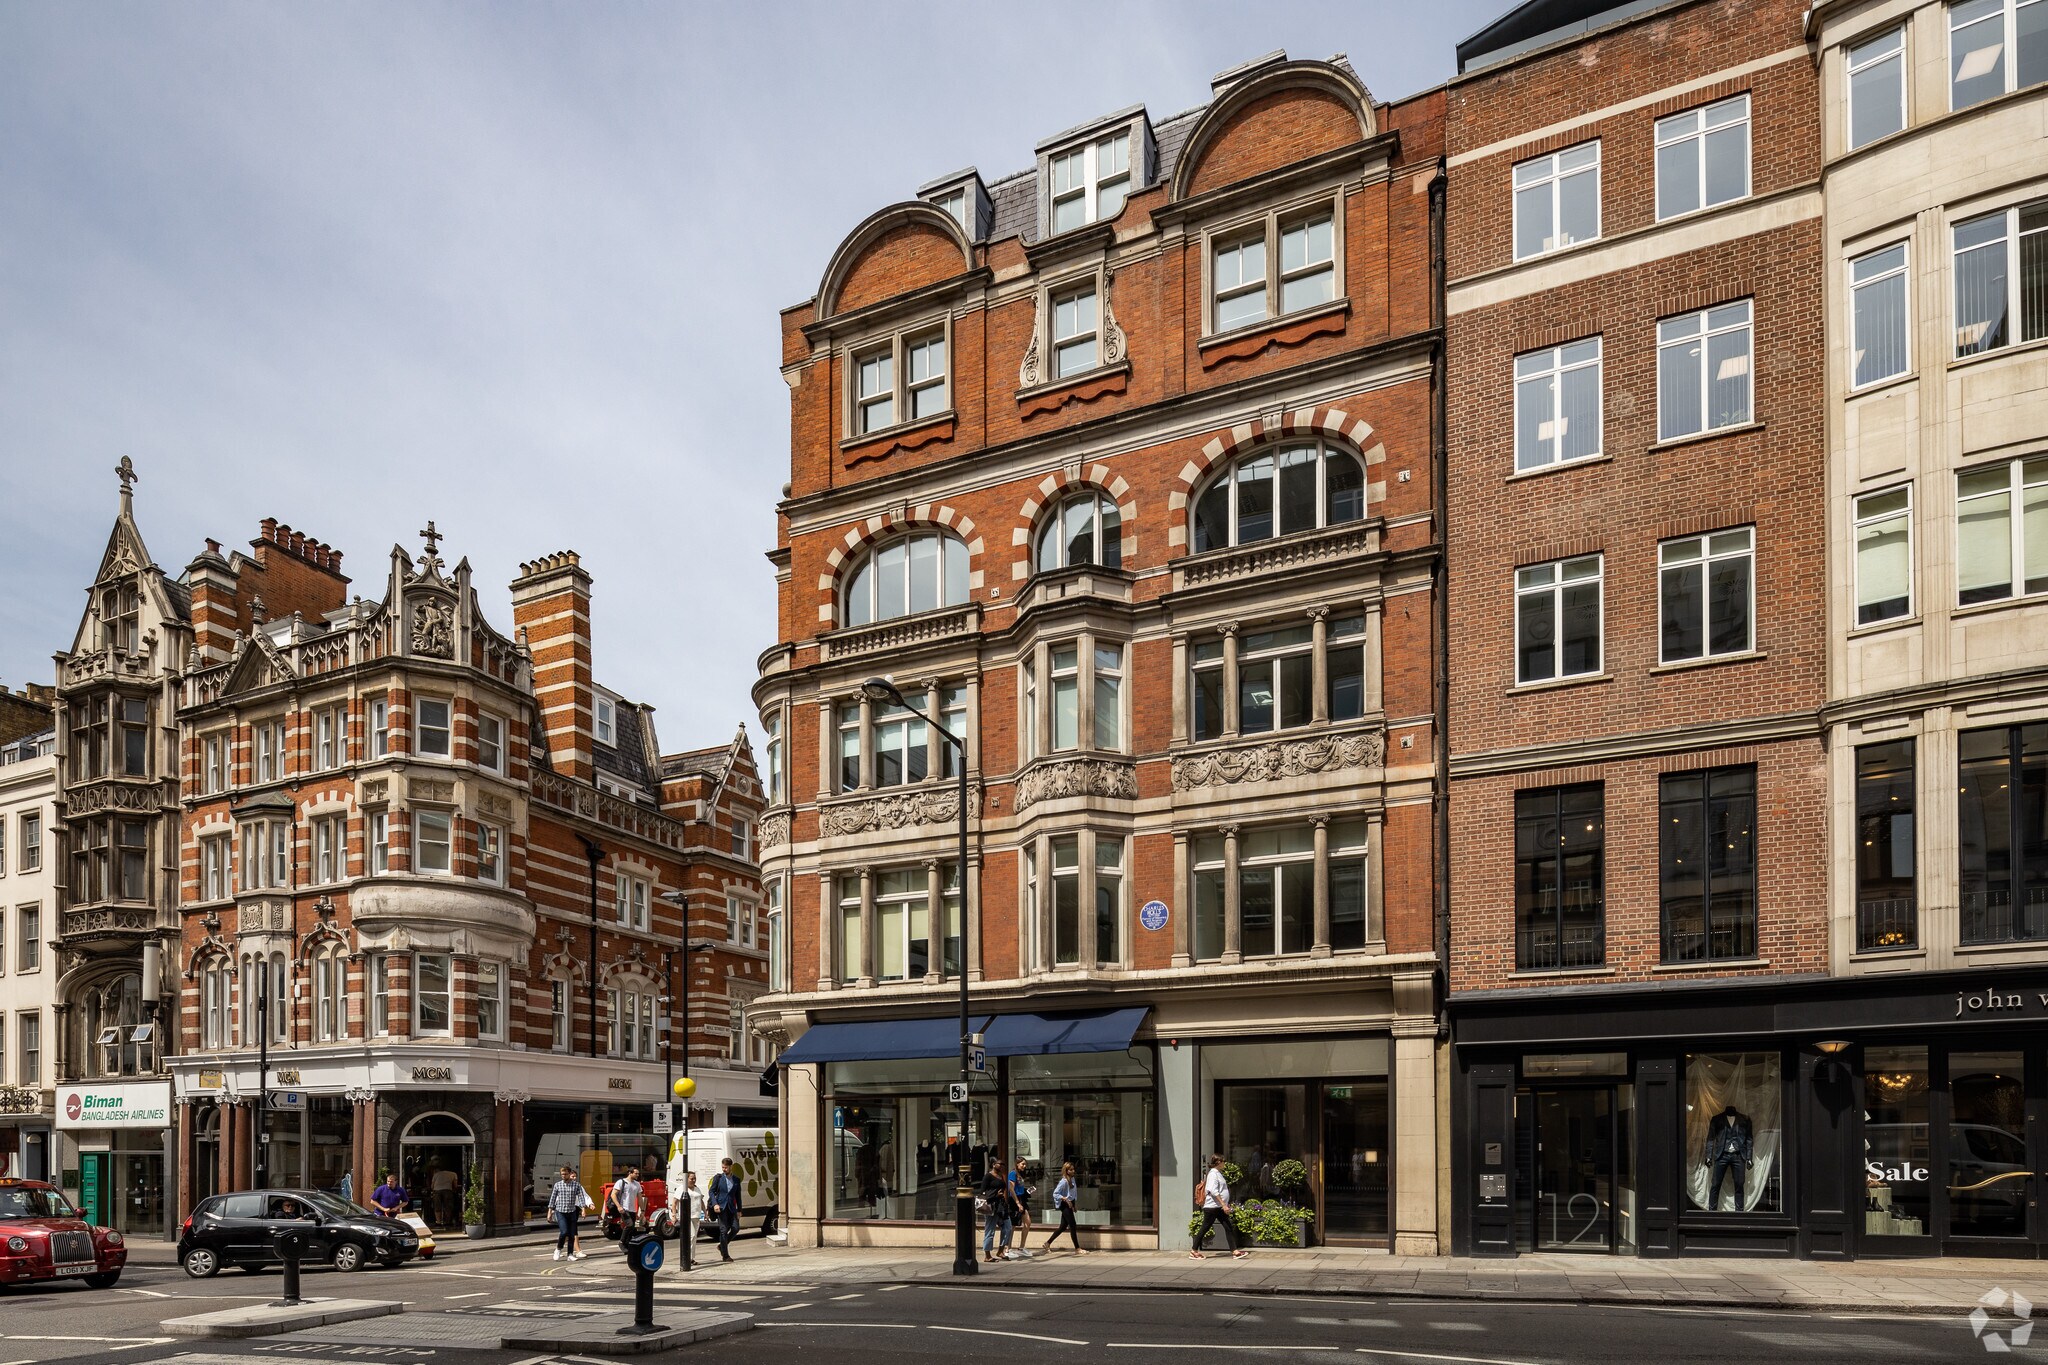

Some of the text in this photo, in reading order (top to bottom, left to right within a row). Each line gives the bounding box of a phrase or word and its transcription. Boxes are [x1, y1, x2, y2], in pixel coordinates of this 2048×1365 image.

[1956, 987, 2024, 1017] john
[976, 1053, 983, 1069] P
[412, 1066, 451, 1080] MCM
[608, 1077, 632, 1089] MCM
[84, 1095, 123, 1108] Biman
[81, 1109, 165, 1121] BANGLADESH AIRLINES
[1867, 1161, 1929, 1181] Sale
[1544, 1193, 1603, 1245] 12
